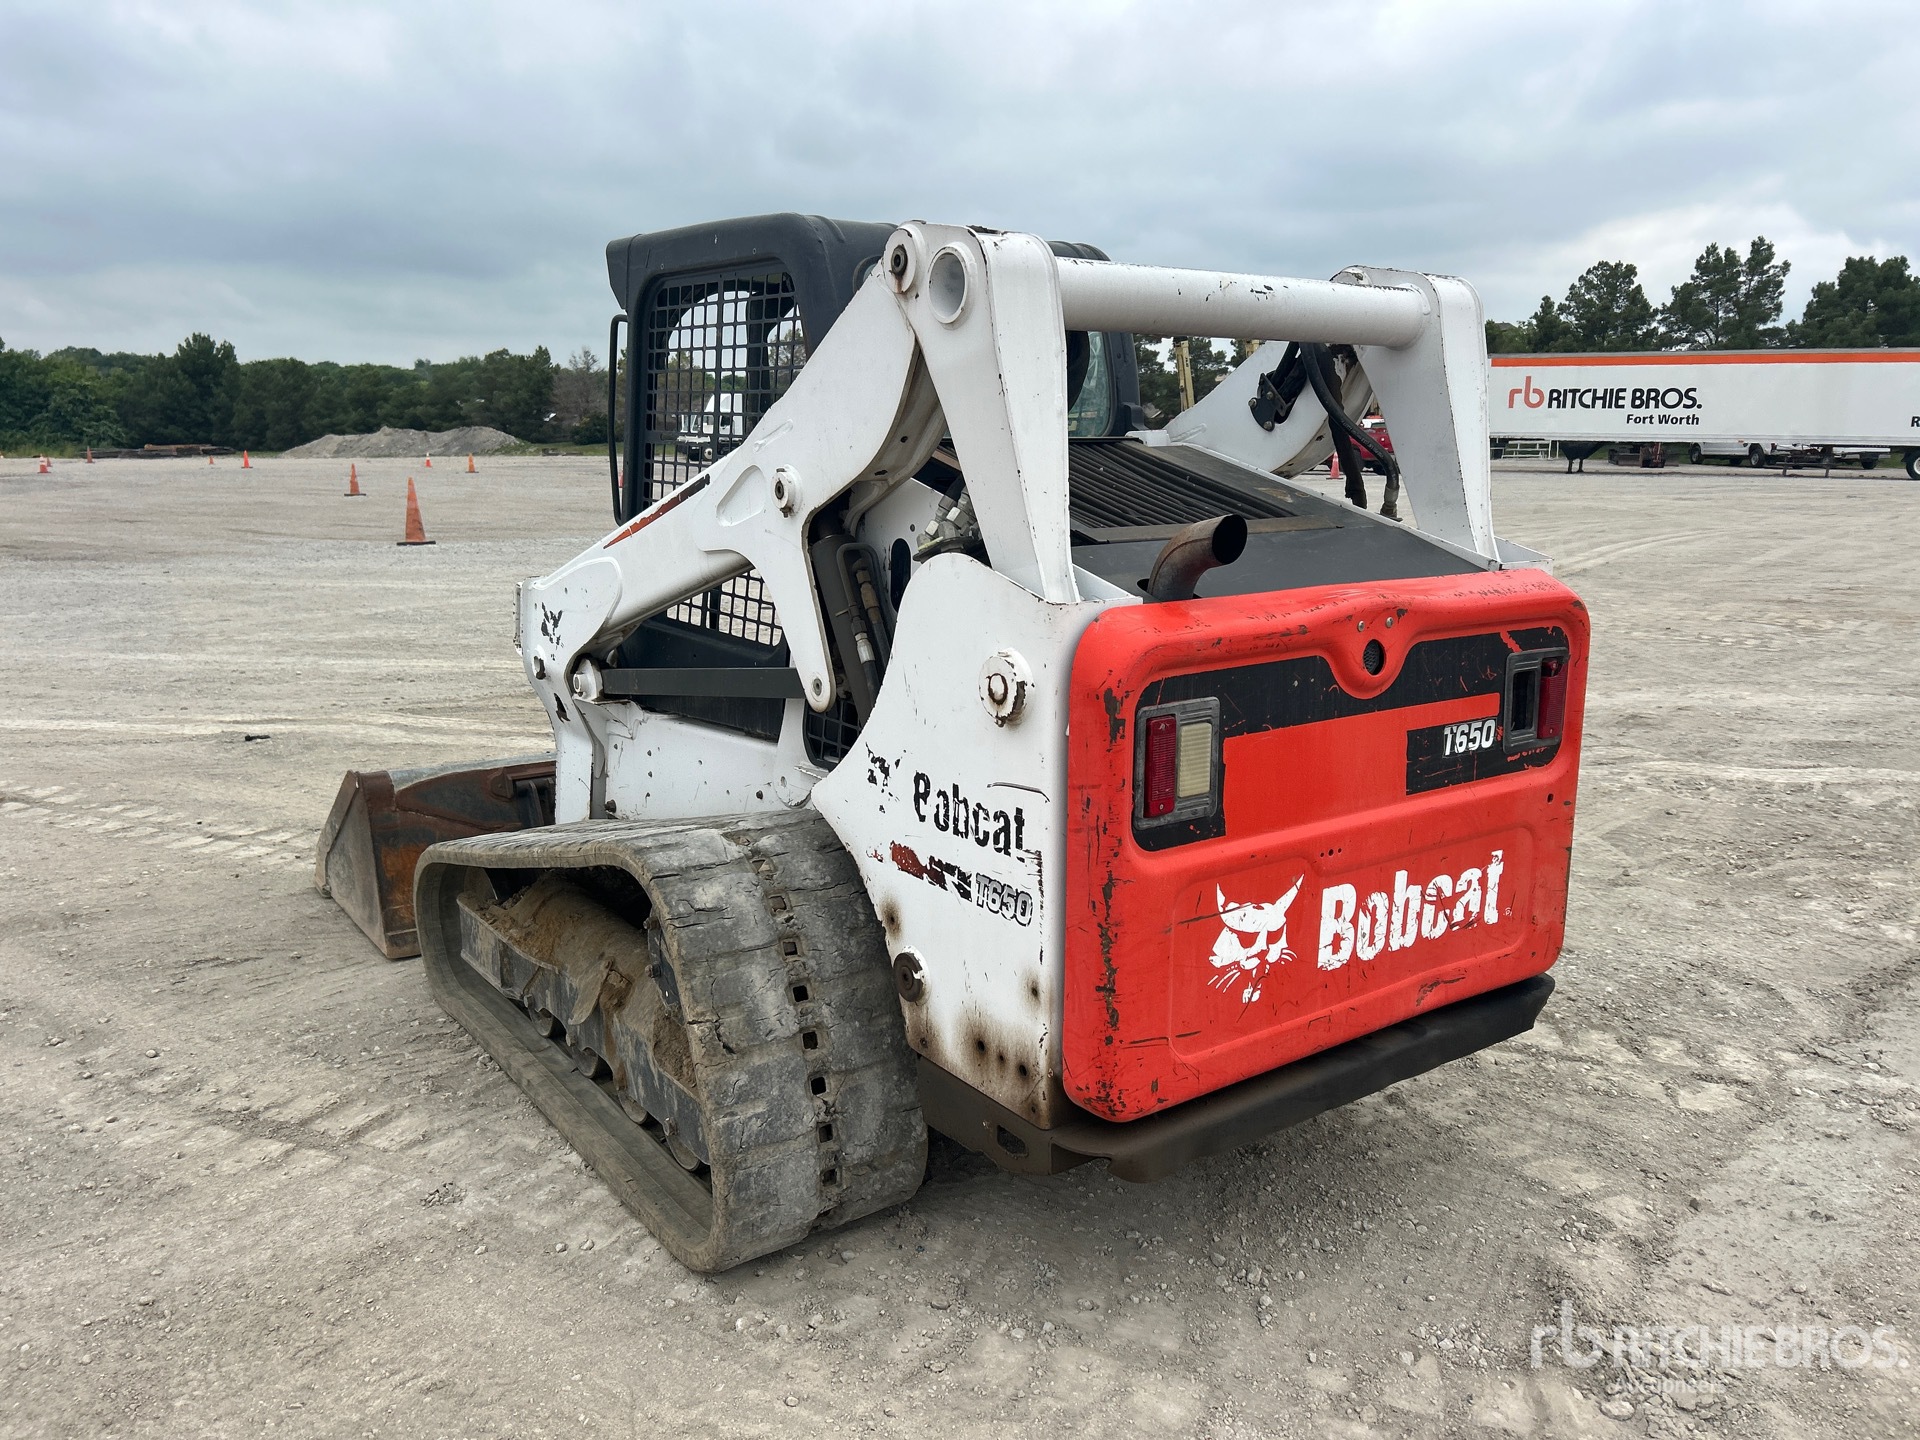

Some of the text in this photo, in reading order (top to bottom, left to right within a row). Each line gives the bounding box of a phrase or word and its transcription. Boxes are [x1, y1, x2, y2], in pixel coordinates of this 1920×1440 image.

[1547, 388, 1626, 409] RITCHIE
[1630, 387, 1703, 409] BROS.
[1626, 413, 1700, 426] Fort Worth
[1443, 719, 1496, 756] T650
[975, 872, 1033, 927] T650
[1317, 850, 1504, 971] Bobcat
